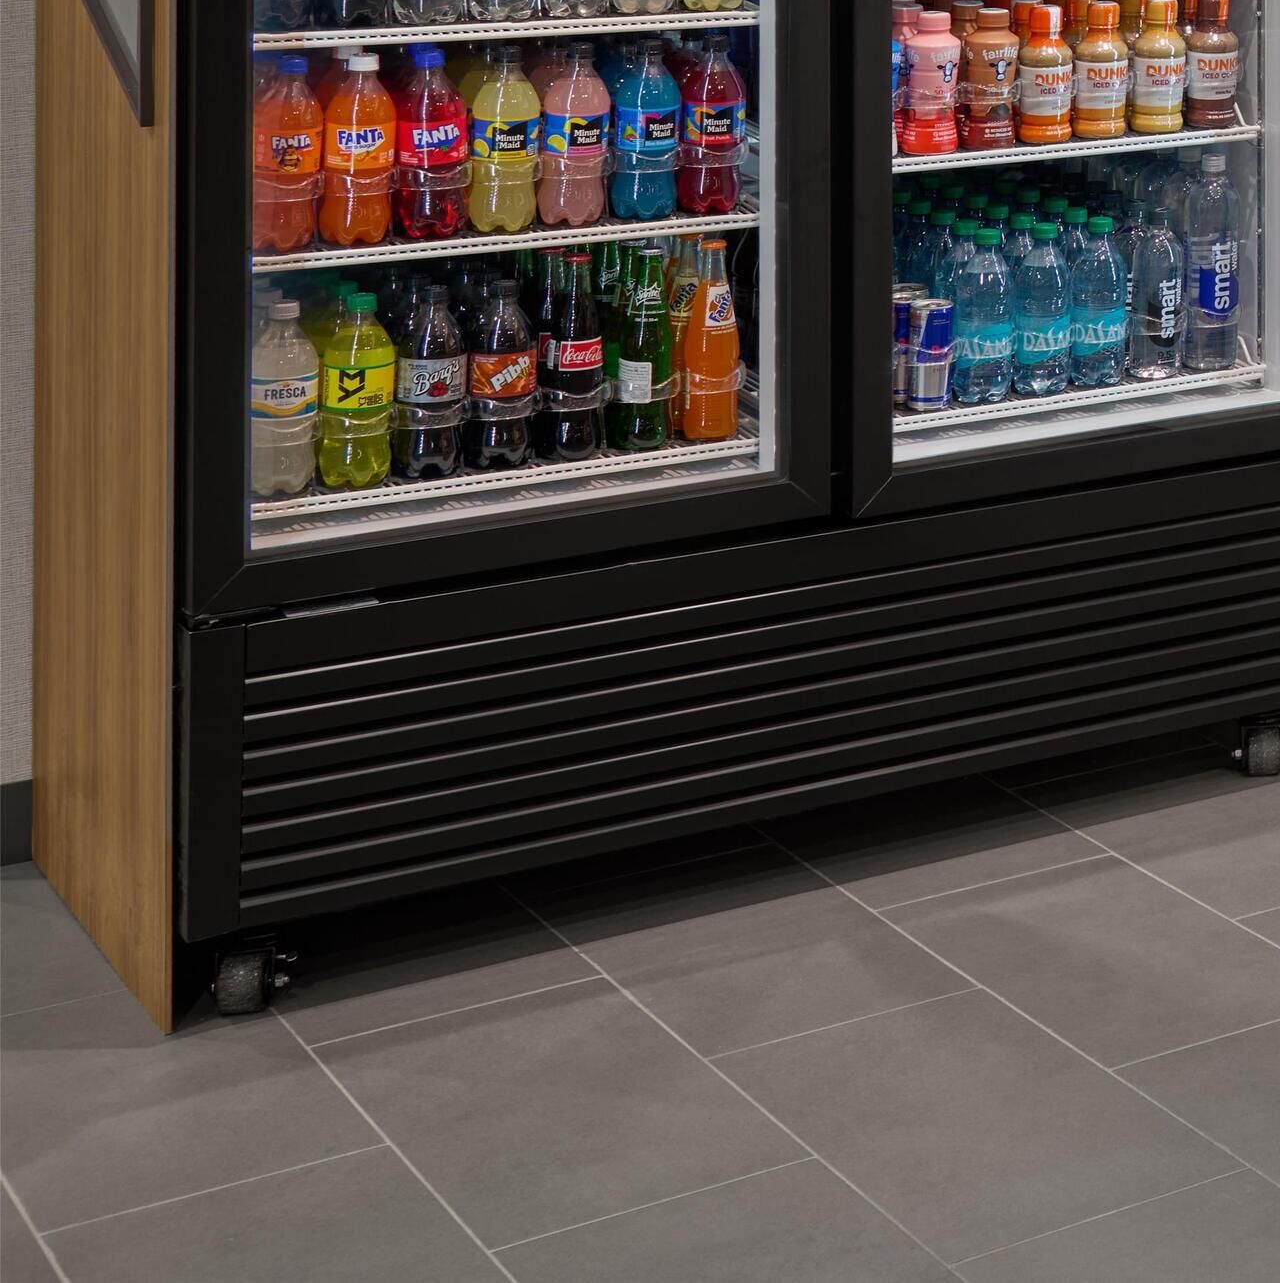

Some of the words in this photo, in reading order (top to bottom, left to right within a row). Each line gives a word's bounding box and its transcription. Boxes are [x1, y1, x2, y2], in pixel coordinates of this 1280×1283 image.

[649, 122, 674, 132] Minute
[703, 118, 731, 128] Minute
[707, 125, 727, 133] Maid
[338, 129, 384, 145] FANTA
[413, 124, 460, 145] FANTA
[495, 134, 524, 142] Minute
[574, 128, 600, 138] Minute
[577, 135, 597, 144] Maid
[653, 129, 671, 138] Maid
[272, 134, 312, 150] FANTA
[1211, 242, 1230, 310] smart
[1161, 279, 1176, 340] smart
[414, 359, 460, 395] Barq's
[490, 355, 530, 392] Pibb
[264, 386, 306, 400] FRESCA
